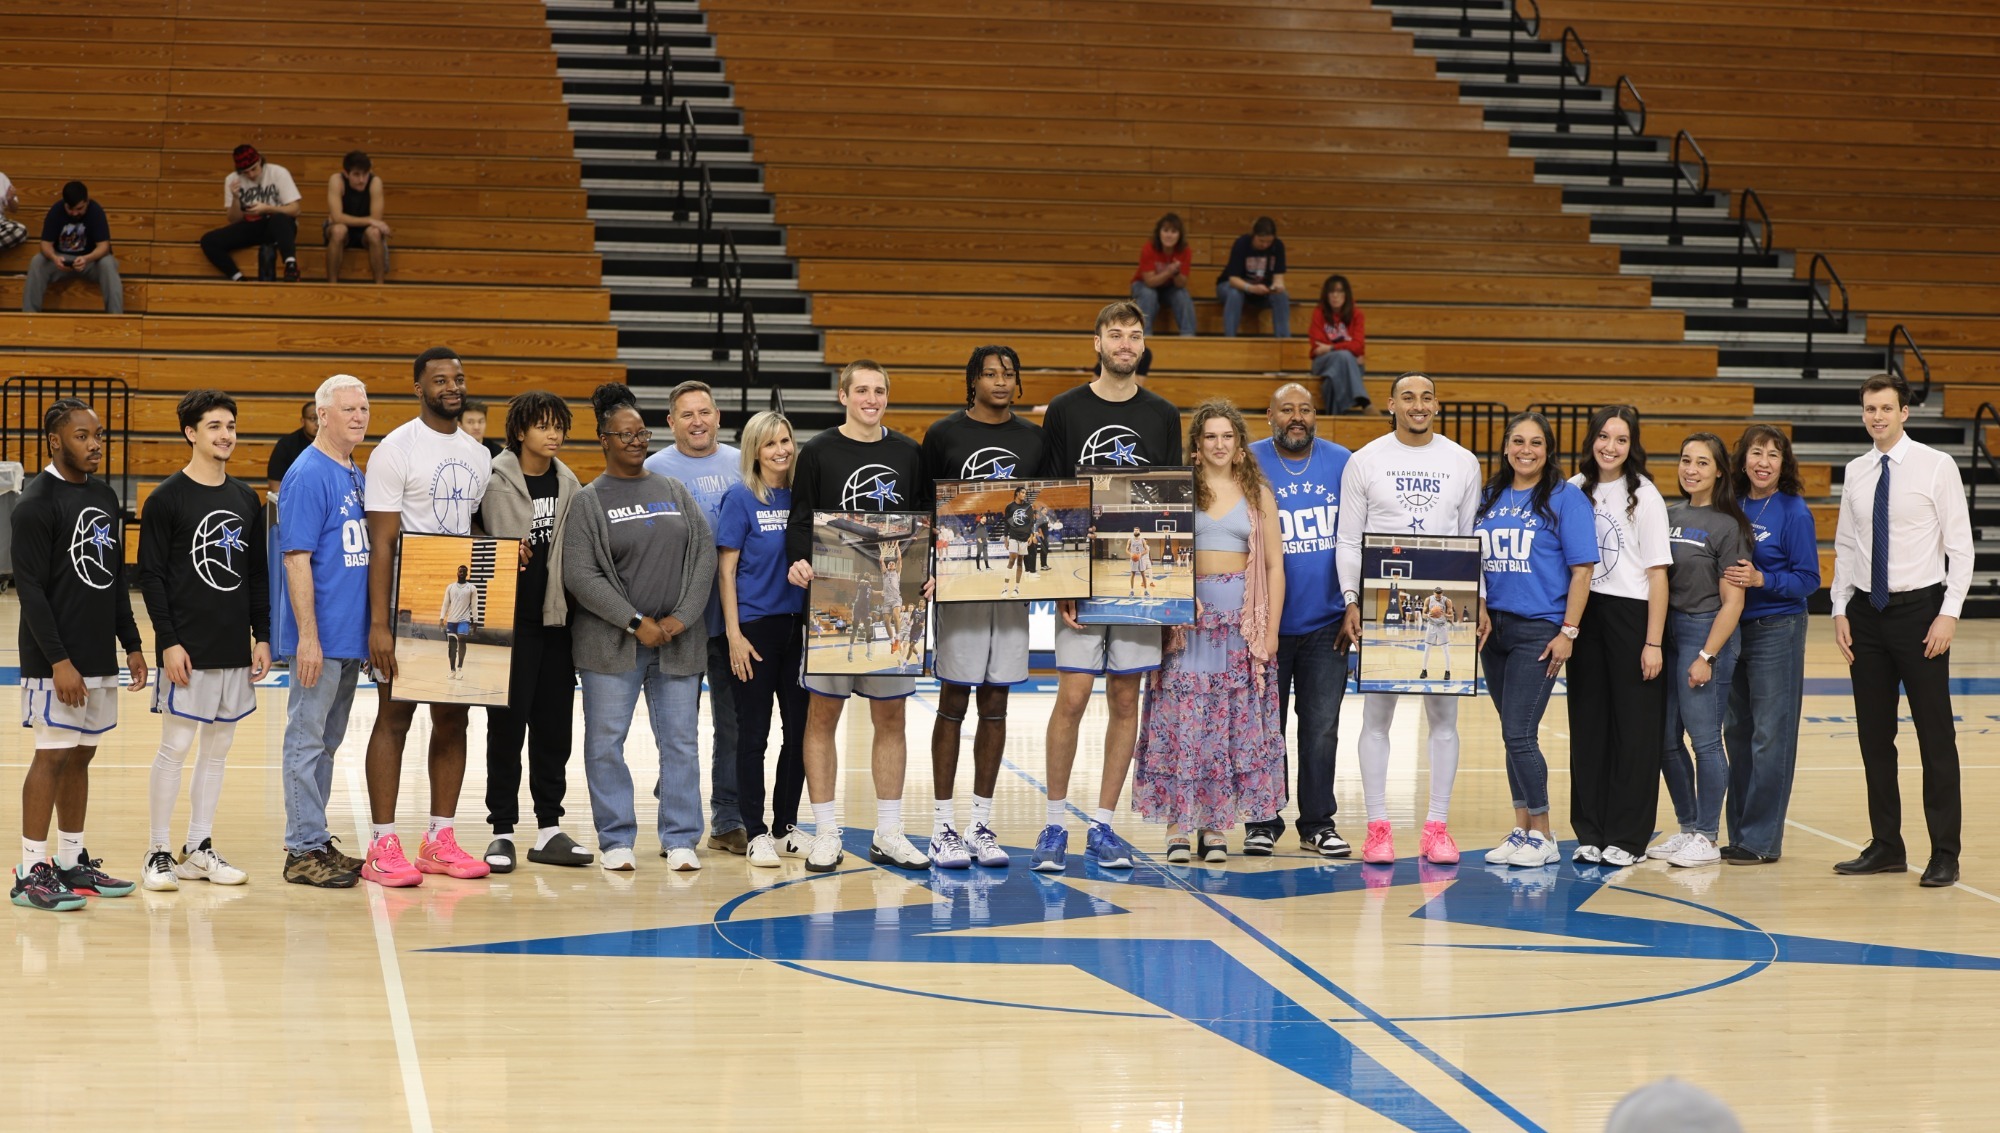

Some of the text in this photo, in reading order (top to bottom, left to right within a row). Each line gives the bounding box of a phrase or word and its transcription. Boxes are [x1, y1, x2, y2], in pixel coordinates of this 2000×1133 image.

[1396, 477, 1441, 493] STARS
[1396, 494, 1440, 513] BASKETBALL
[1283, 536, 1337, 554] ASKETBALL
[1473, 528, 1535, 560] OCU
[1483, 560, 1532, 573] ASKETBALL
